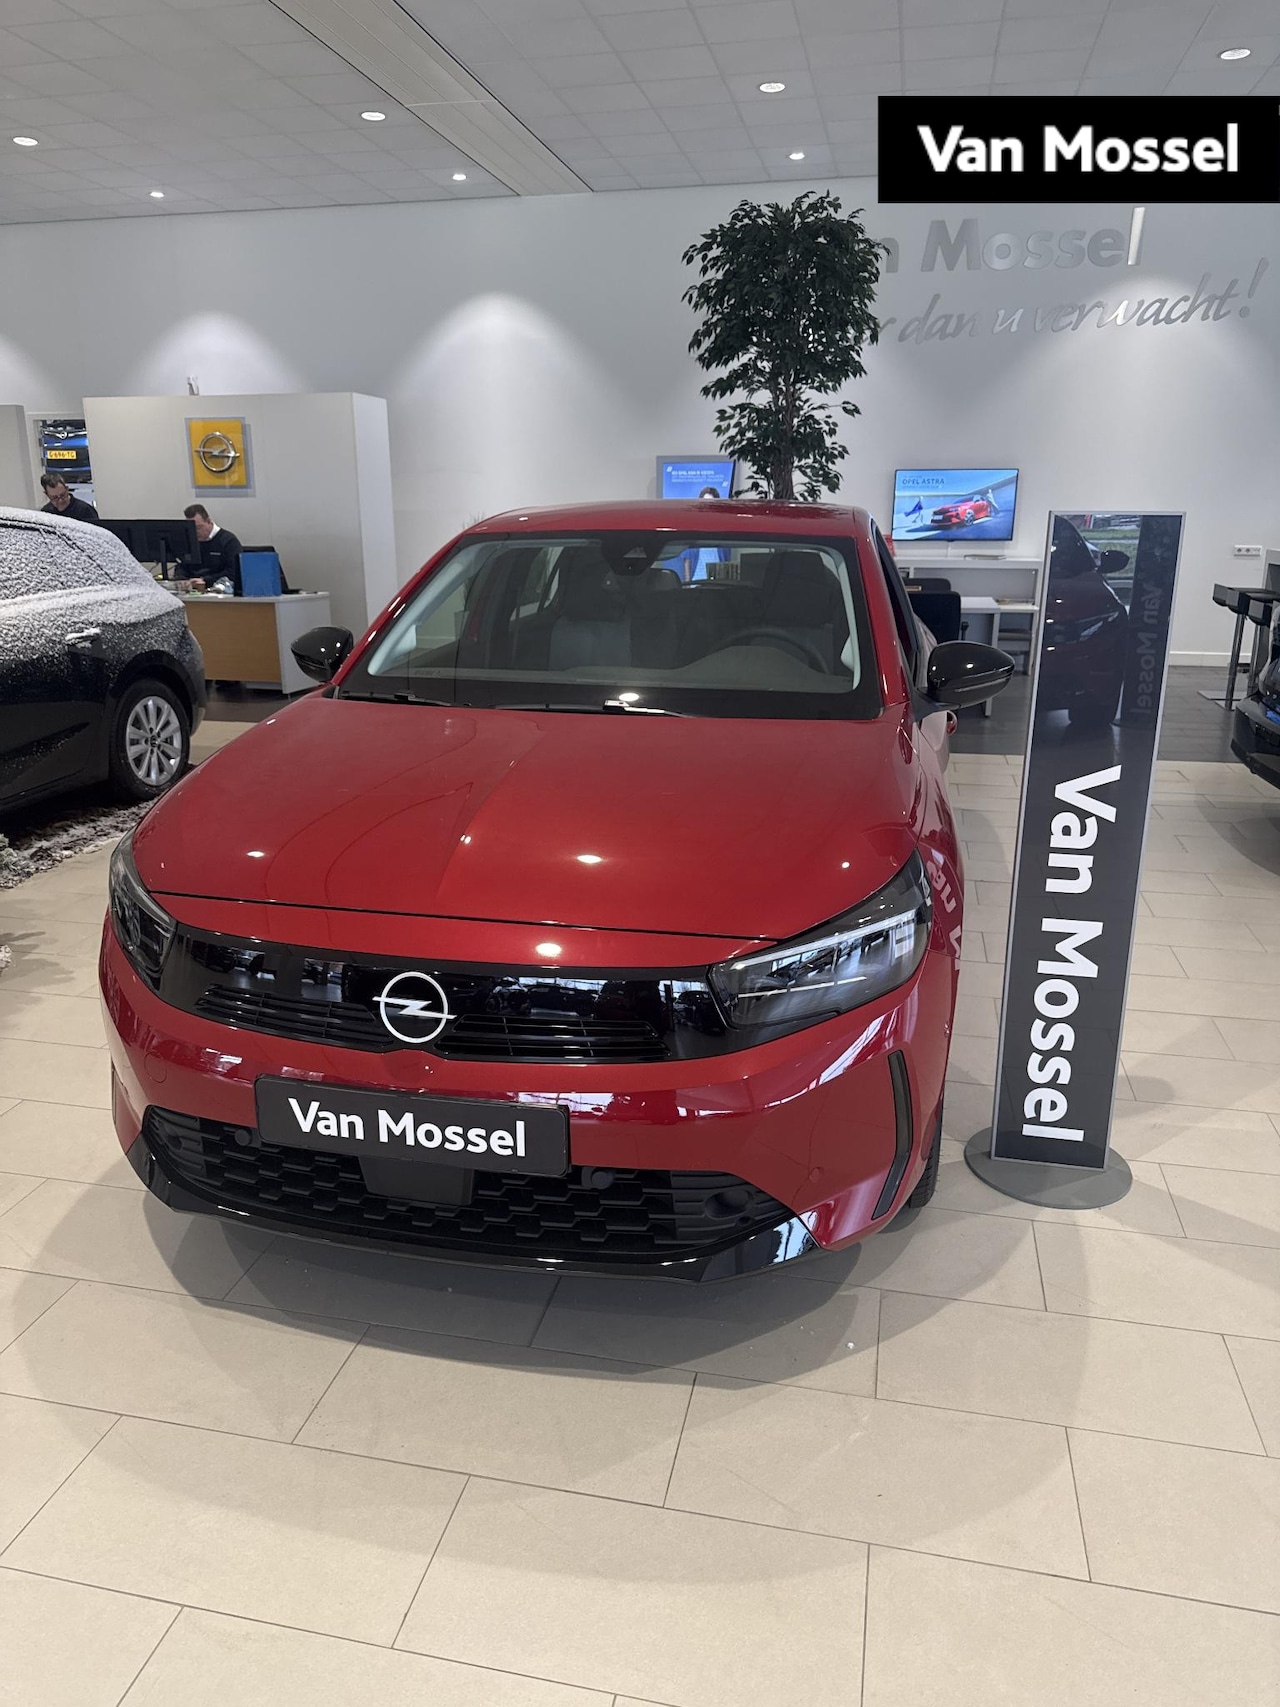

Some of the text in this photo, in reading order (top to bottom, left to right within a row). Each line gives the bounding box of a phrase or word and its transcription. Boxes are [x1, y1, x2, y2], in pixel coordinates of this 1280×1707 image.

[920, 206, 1145, 272] Mossel
[898, 293, 979, 345] dan
[992, 308, 1024, 334] u
[1034, 257, 1270, 333] verwacht!
[1021, 764, 1122, 1142] Van Mossel
[287, 1097, 526, 1157] Van Mossel
